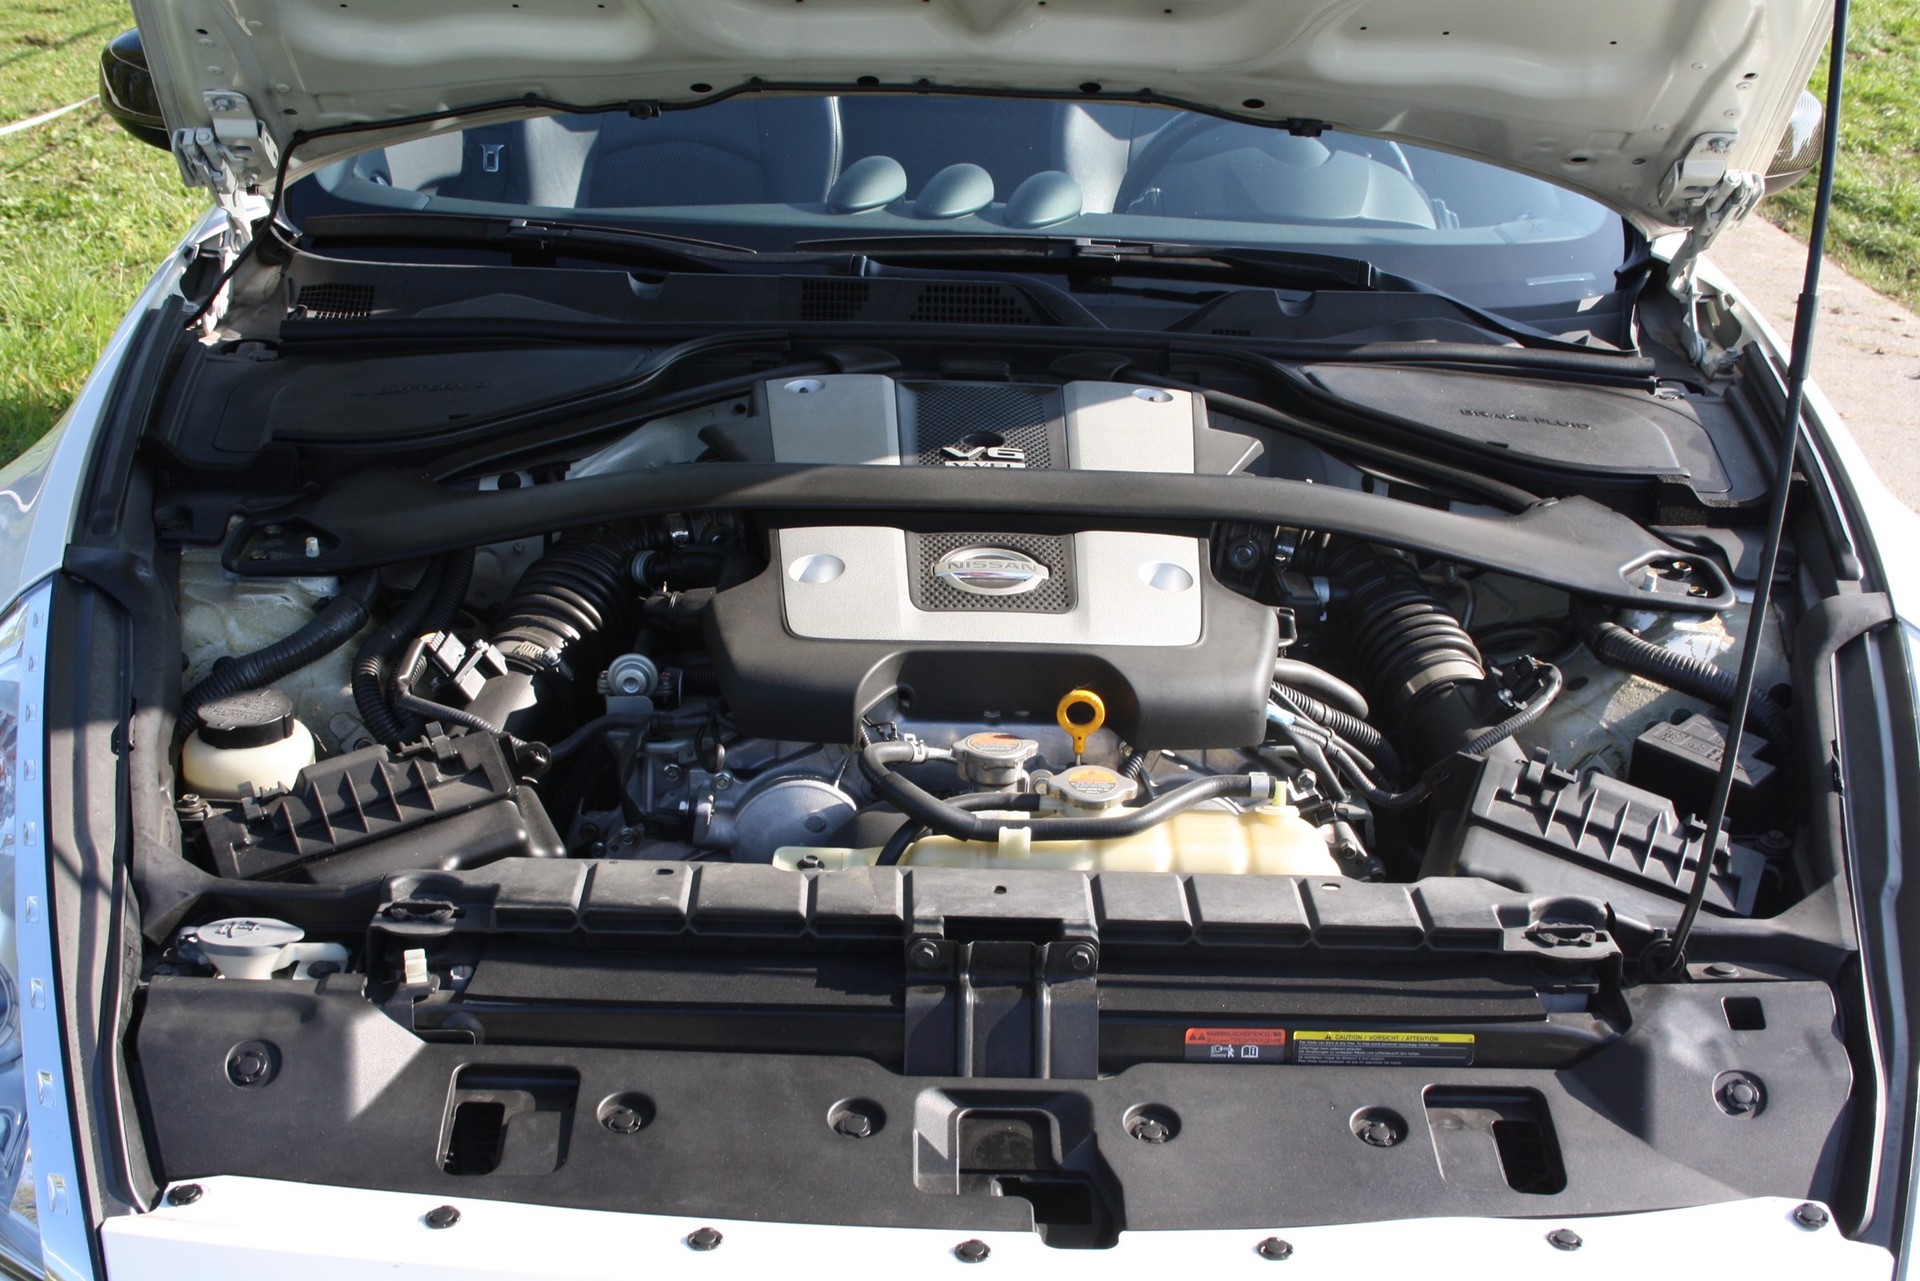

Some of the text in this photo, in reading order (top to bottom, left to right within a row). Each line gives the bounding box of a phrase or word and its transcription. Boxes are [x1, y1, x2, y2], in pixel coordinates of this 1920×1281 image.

[1460, 408, 1592, 430] BRAKE FLUID
[941, 446, 1025, 460] V6
[946, 560, 1037, 573] NISSAN
